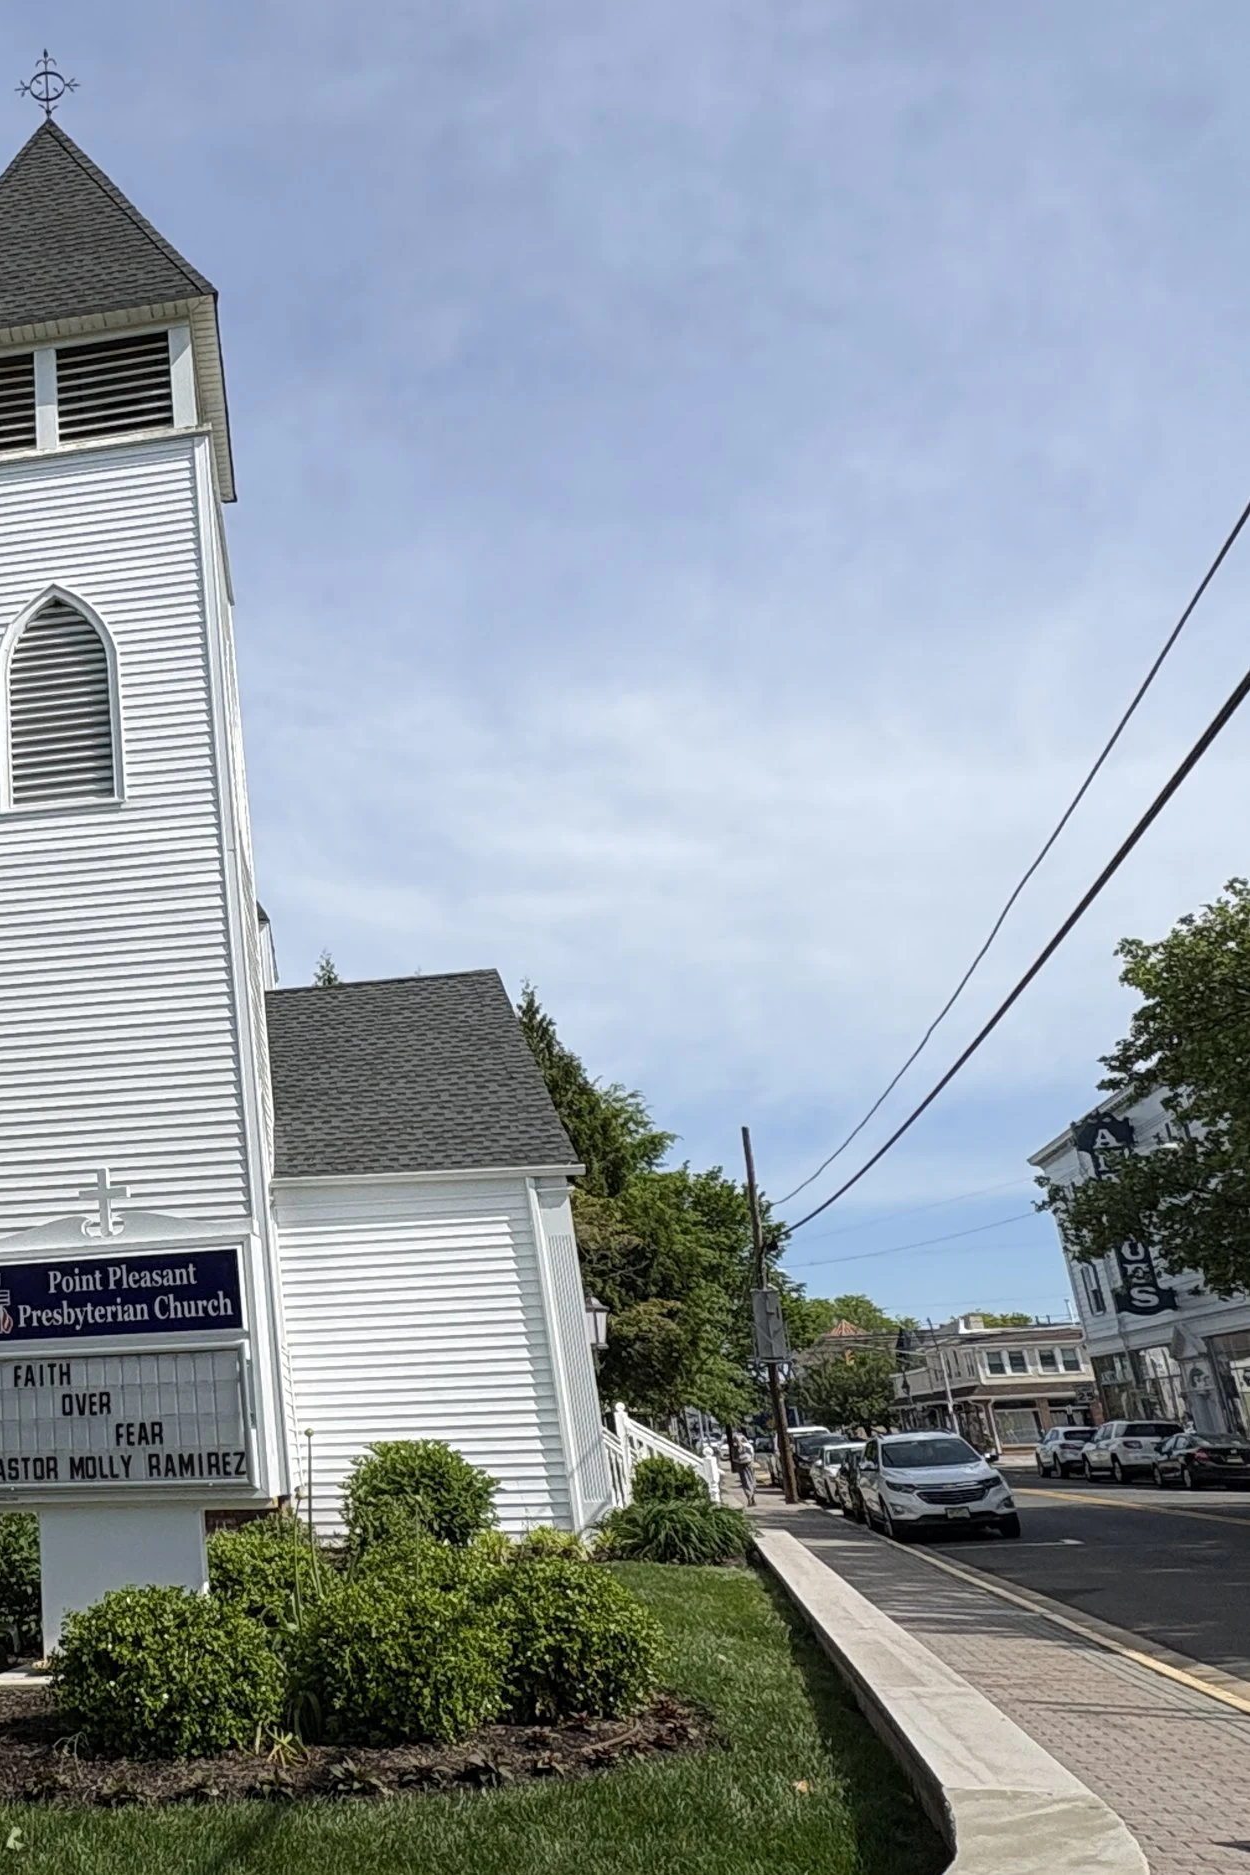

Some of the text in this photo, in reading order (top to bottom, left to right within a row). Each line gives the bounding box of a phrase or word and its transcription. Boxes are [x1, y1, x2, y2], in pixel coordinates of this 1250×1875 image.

[48, 1263, 197, 1294] Point Pleasant
[17, 1290, 234, 1330] Presbyterian Church
[13, 1363, 72, 1388] FAITH
[61, 1391, 111, 1416] OVER
[1078, 1391, 1095, 1401] 25
[115, 1421, 164, 1447] FEAR
[69, 1454, 132, 1480] MOLLY
[148, 1451, 247, 1478] RAMIREZ
